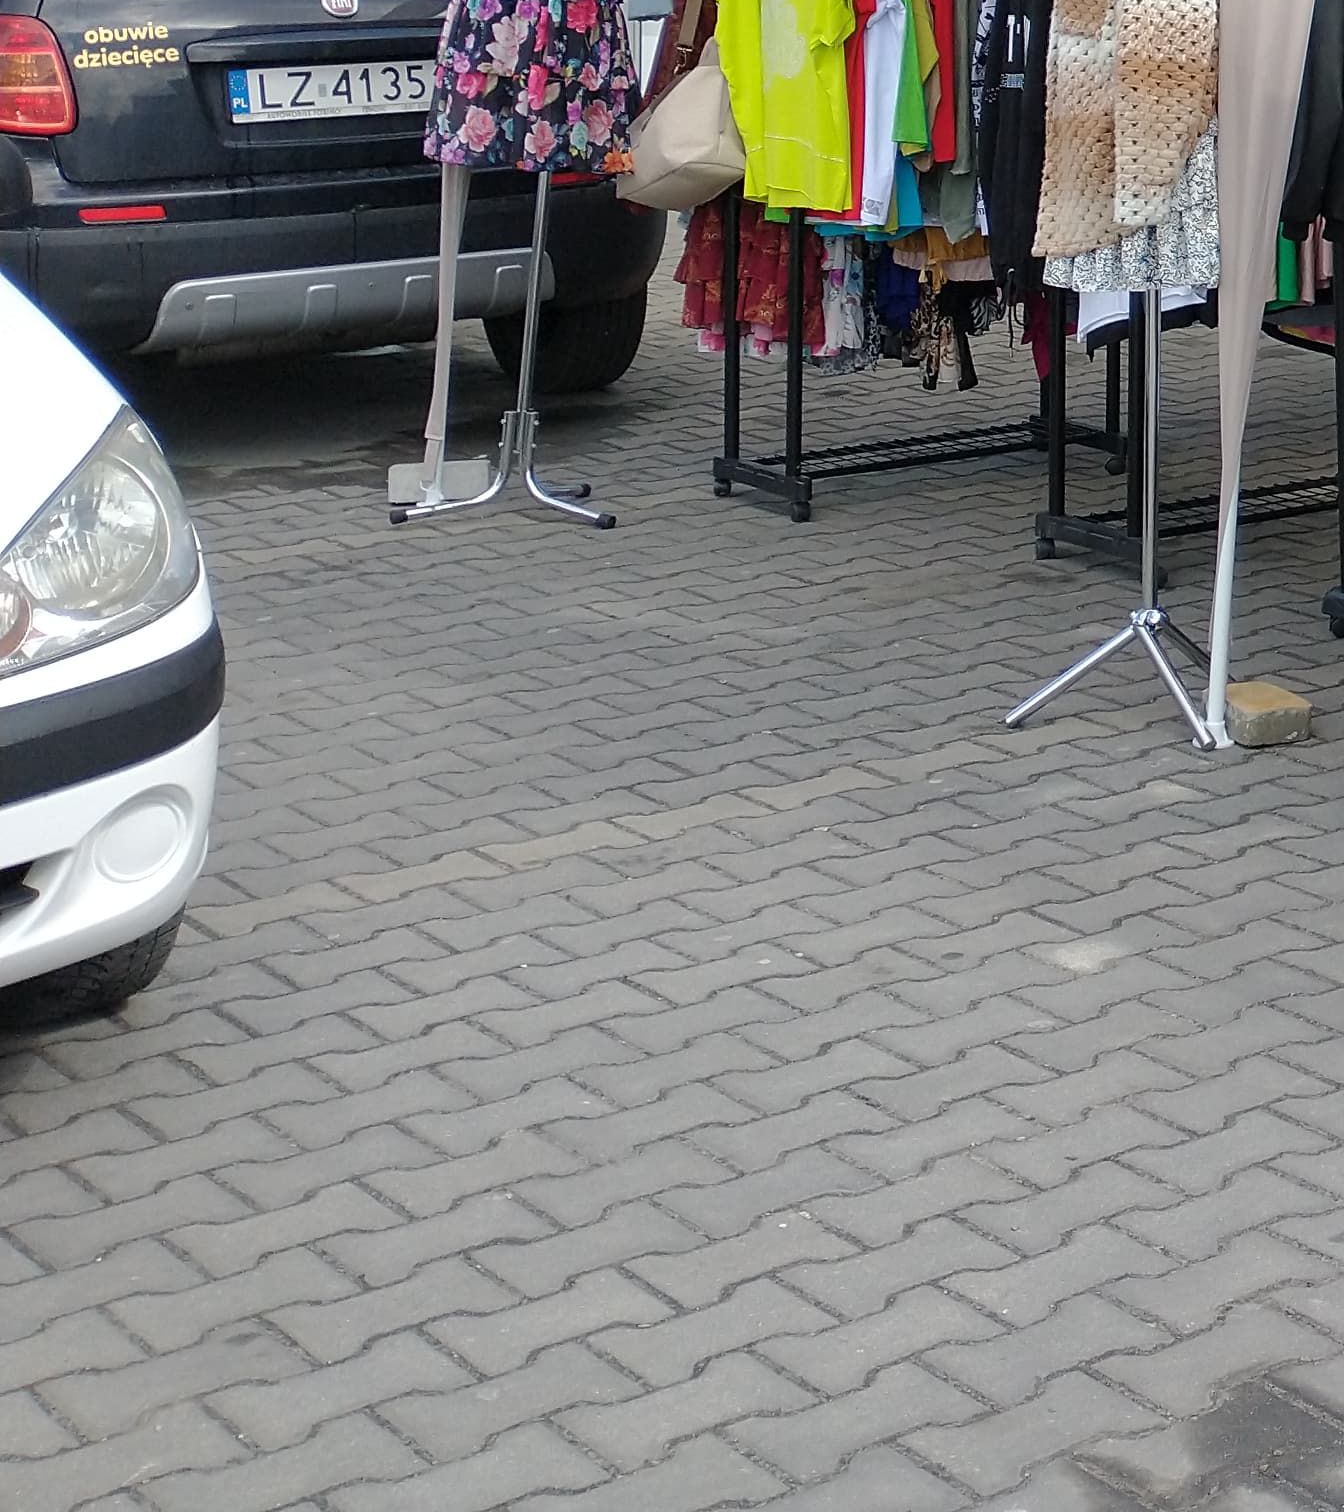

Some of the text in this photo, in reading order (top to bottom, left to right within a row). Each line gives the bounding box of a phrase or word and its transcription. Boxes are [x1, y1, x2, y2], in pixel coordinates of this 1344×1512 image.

[83, 22, 169, 45] obuwie
[73, 44, 180, 68] dziecięce
[258, 65, 426, 109] LZ 4135
[233, 97, 248, 108] PL
